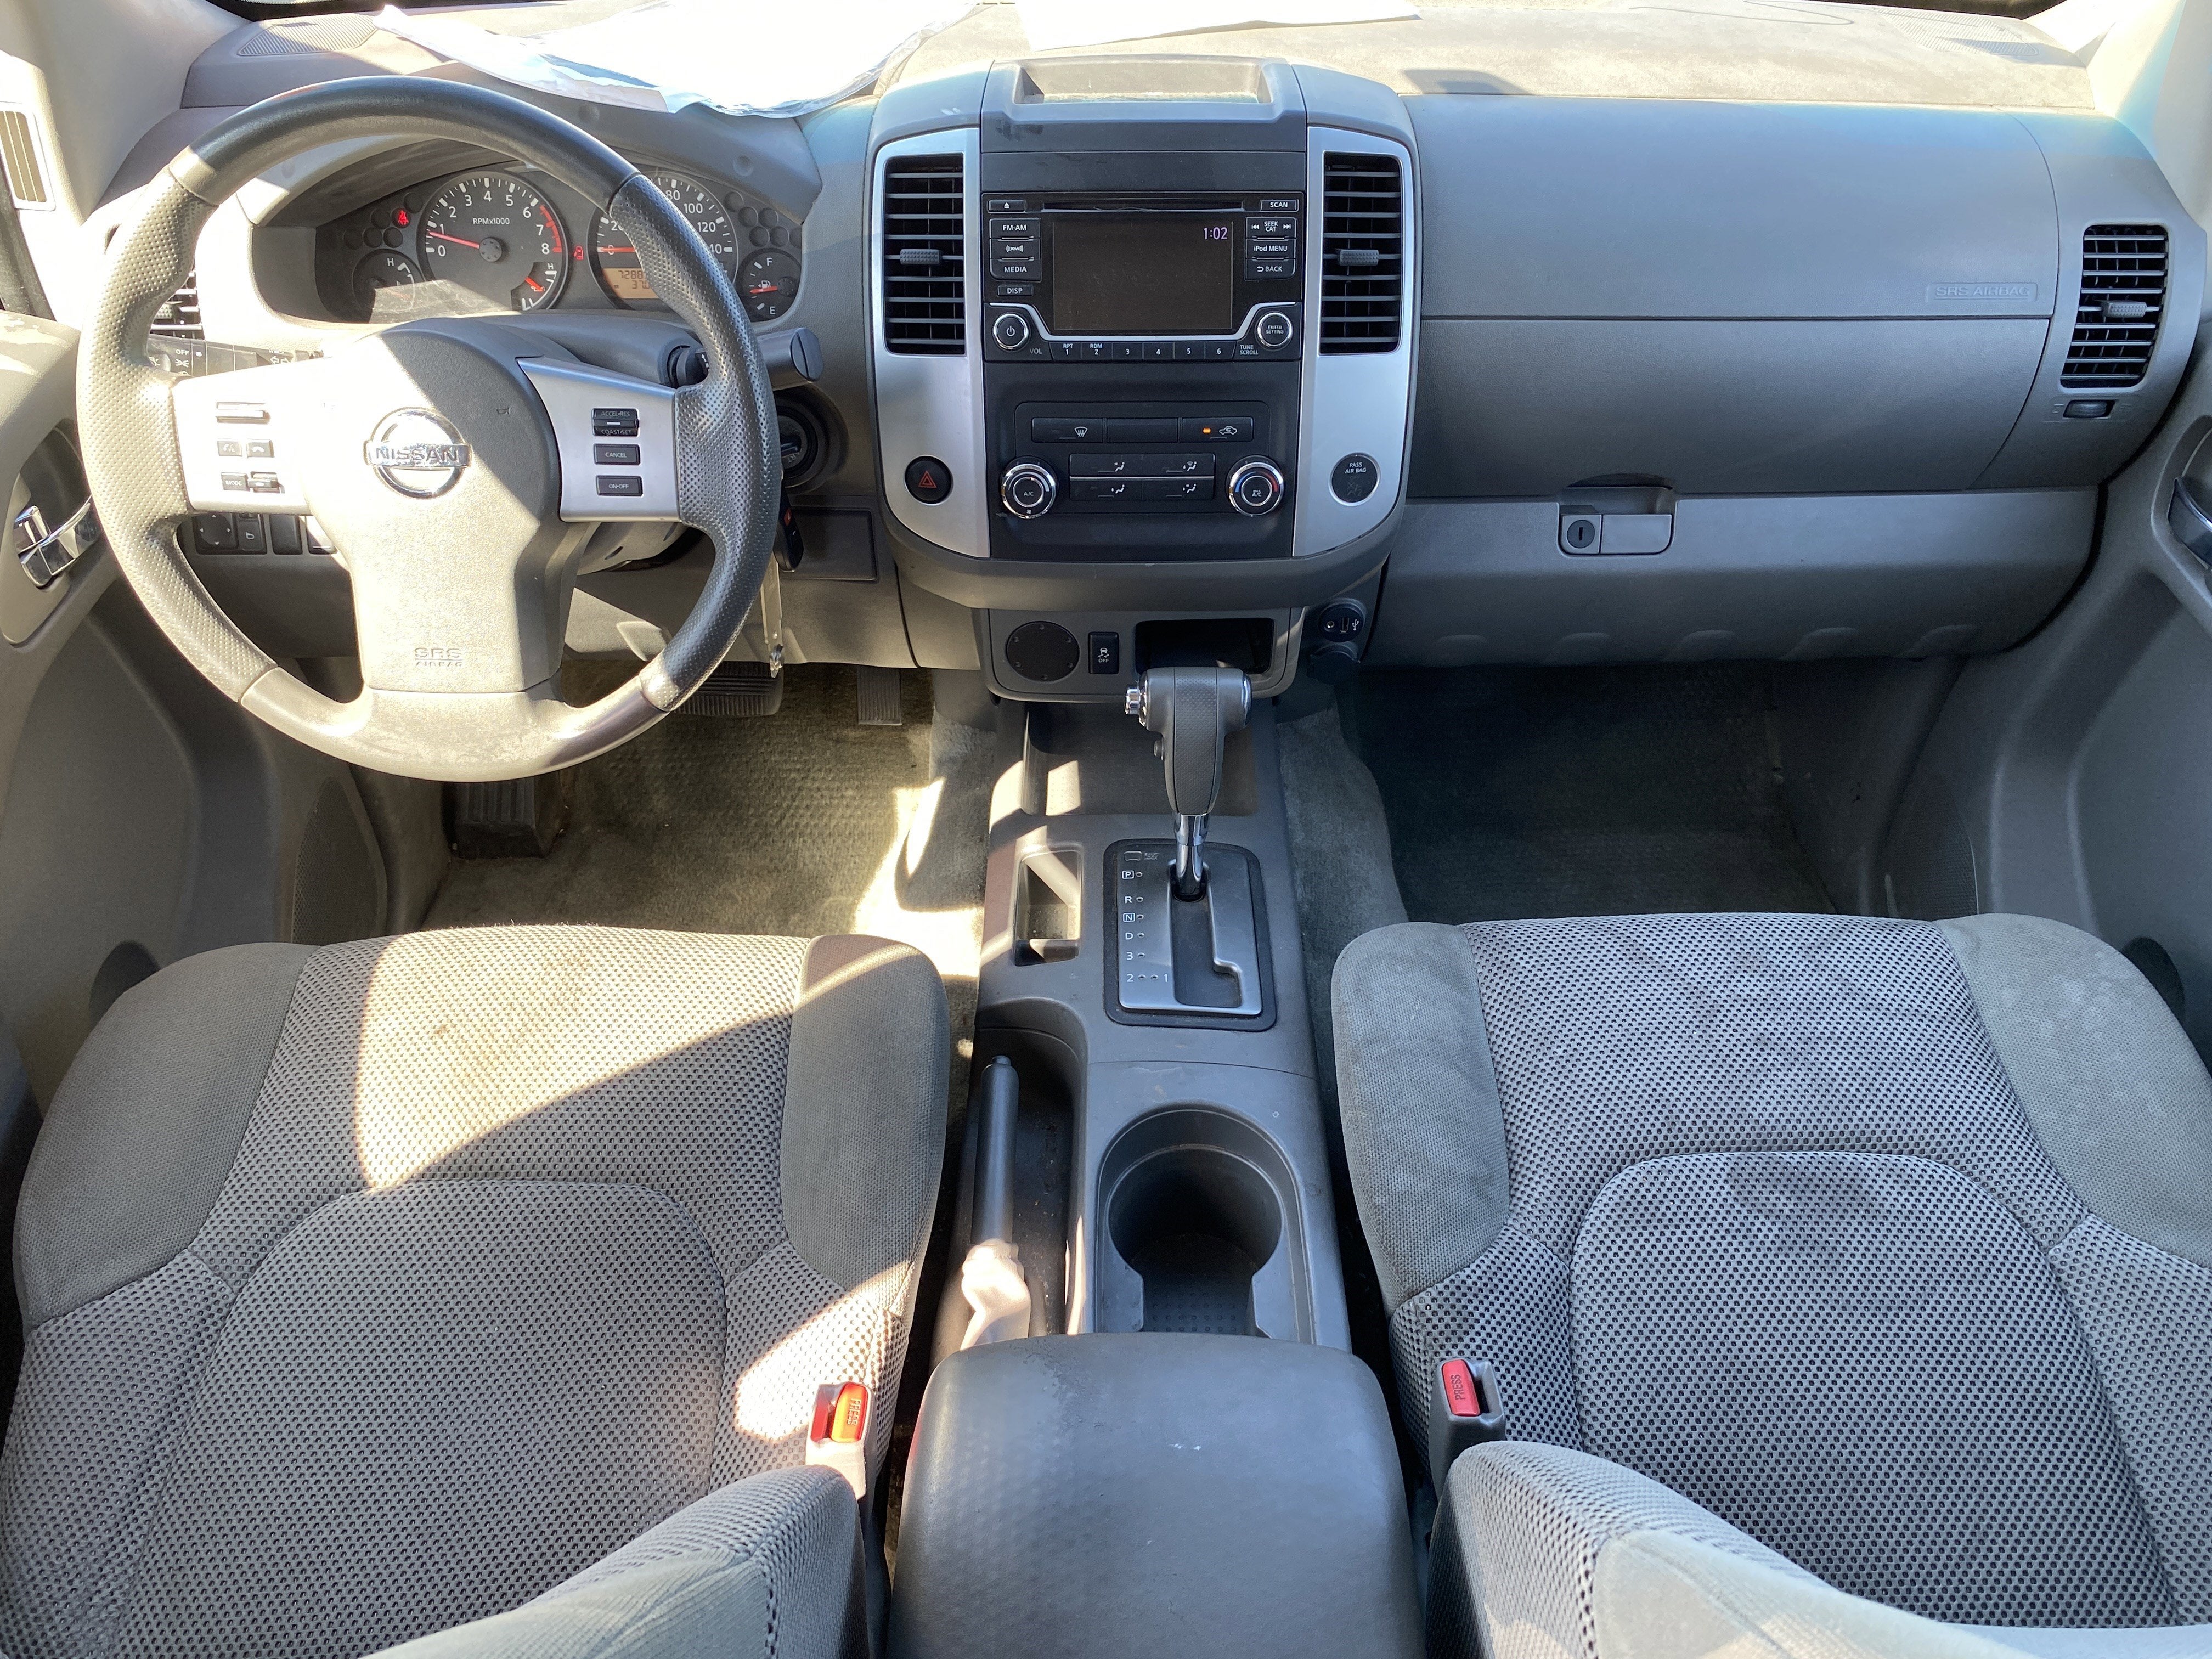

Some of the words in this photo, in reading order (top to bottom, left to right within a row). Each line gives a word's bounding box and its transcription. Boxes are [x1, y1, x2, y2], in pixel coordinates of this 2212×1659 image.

[465, 195, 472, 206] 3
[484, 190, 492, 201] 4
[506, 195, 514, 206] 5
[449, 206, 457, 218] 2
[523, 206, 531, 218] 6
[684, 203, 703, 213] 100
[536, 225, 544, 236] 7
[697, 222, 716, 232] 120
[1204, 227, 1228, 240] 1:02
[438, 245, 445, 257] 0
[541, 243, 550, 254] 8
[387, 258, 394, 267] H
[766, 258, 772, 266] F
[1936, 286, 1970, 296] SRS
[1973, 286, 2030, 296] AIRBAG
[769, 307, 776, 315] E
[376, 448, 459, 463] NISSAN
[1126, 952, 1133, 960] 3
[1127, 974, 1134, 982] 2
[1164, 974, 1168, 982] 1
[1451, 1374, 1466, 1400] PRESS
